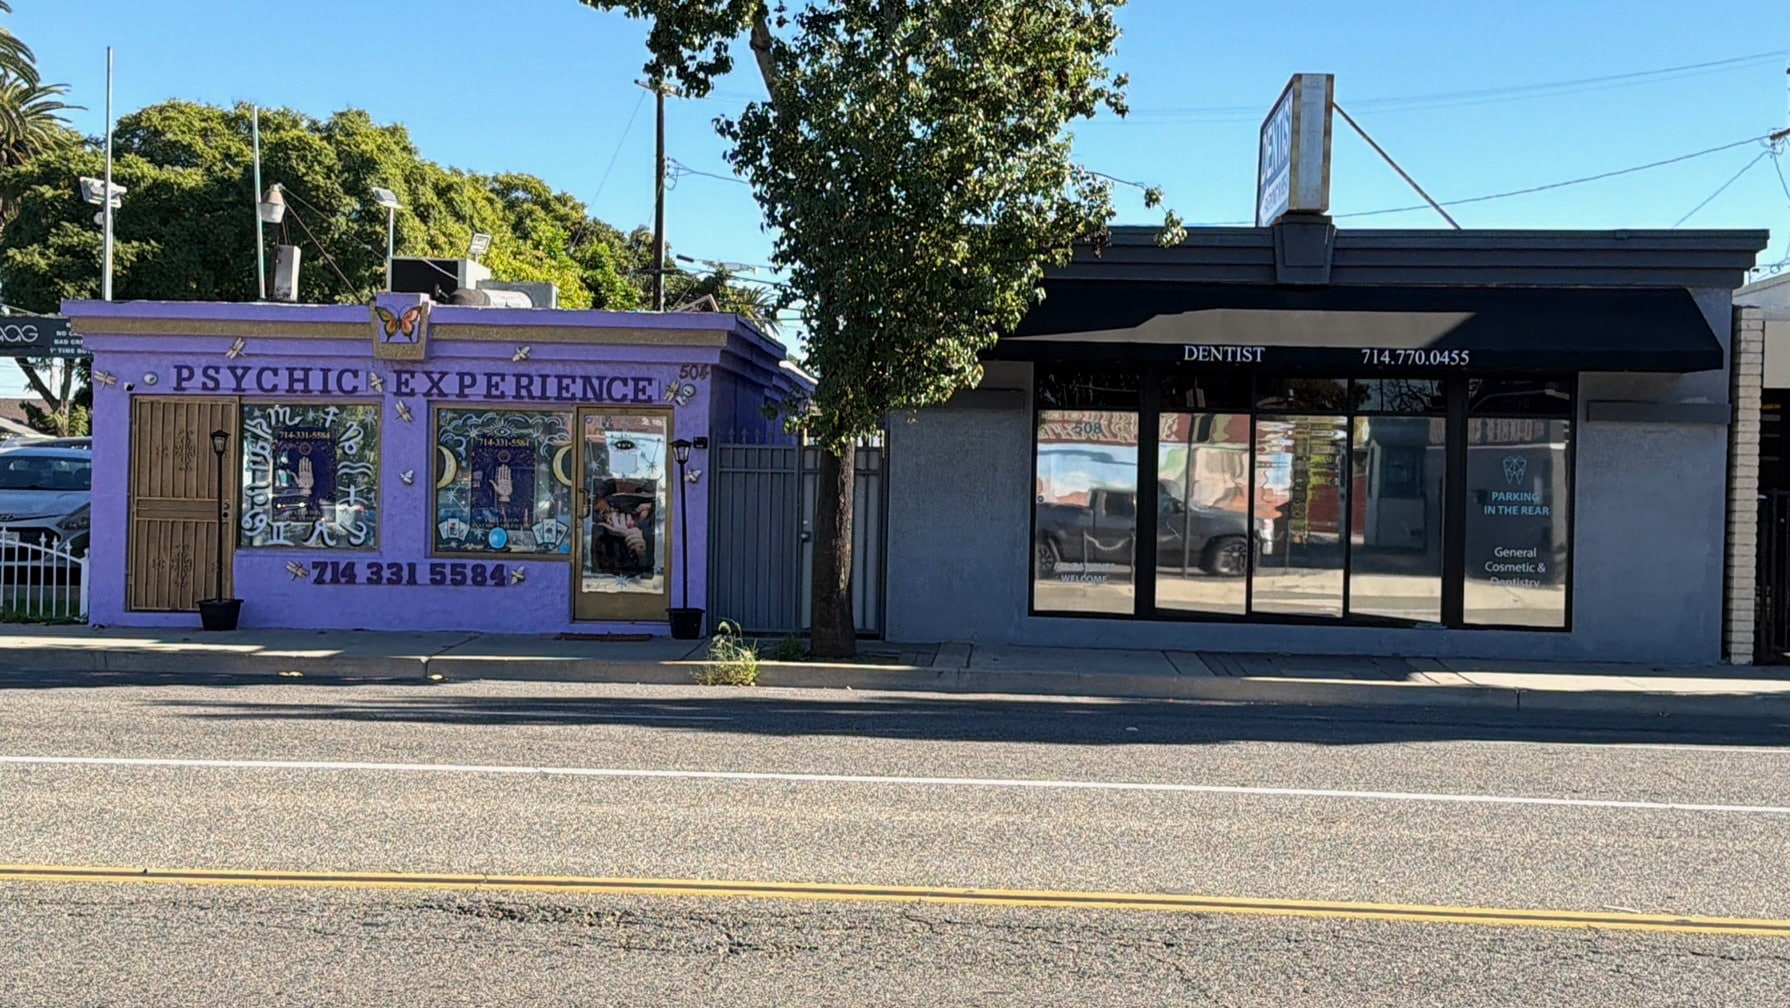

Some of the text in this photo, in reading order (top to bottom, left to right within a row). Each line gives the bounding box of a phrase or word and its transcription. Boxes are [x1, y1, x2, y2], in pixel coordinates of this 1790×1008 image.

[1183, 345, 1470, 366] DENTIST 714.770.0455
[679, 362, 710, 380] 504
[173, 365, 654, 402] PSYCHIC EXPERIENCE
[1073, 421, 1103, 434] 508
[1491, 491, 1540, 502] PARKING
[1484, 505, 1549, 516] IN THE REAR
[1494, 546, 1537, 558] General
[1485, 561, 1546, 573] Cosmetic &
[312, 561, 506, 587] 714 331 5584
[1061, 574, 1107, 583] WELCOME
[1490, 576, 1541, 588] Dentistry
